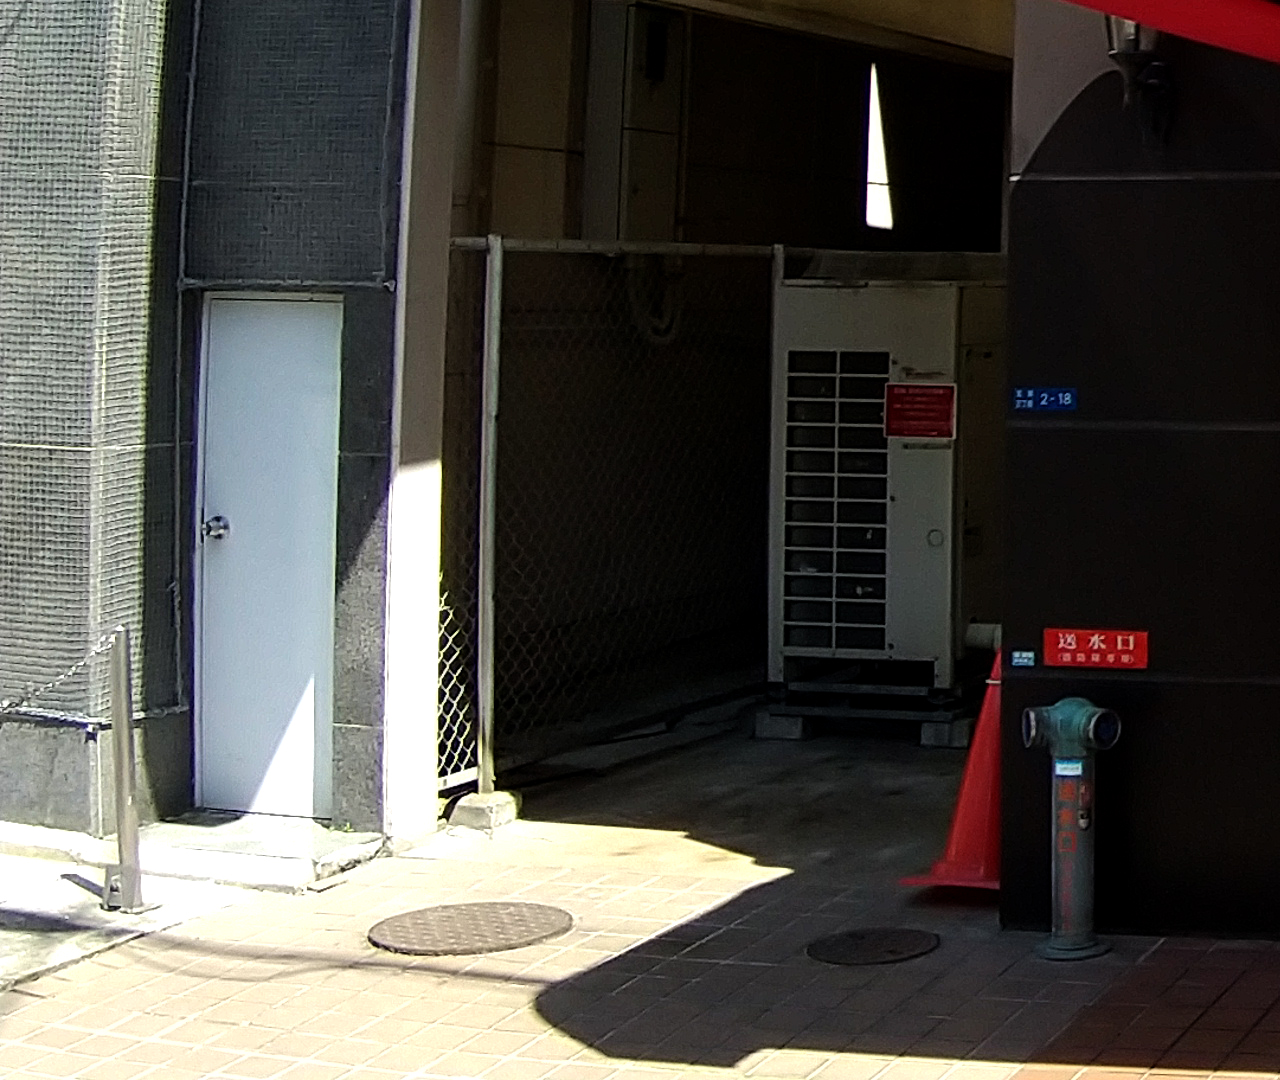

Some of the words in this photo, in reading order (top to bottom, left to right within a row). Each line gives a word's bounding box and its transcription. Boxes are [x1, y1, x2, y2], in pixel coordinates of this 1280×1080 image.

[1040, 393, 1072, 406] 2-18
[1058, 633, 1134, 650] 送水口
